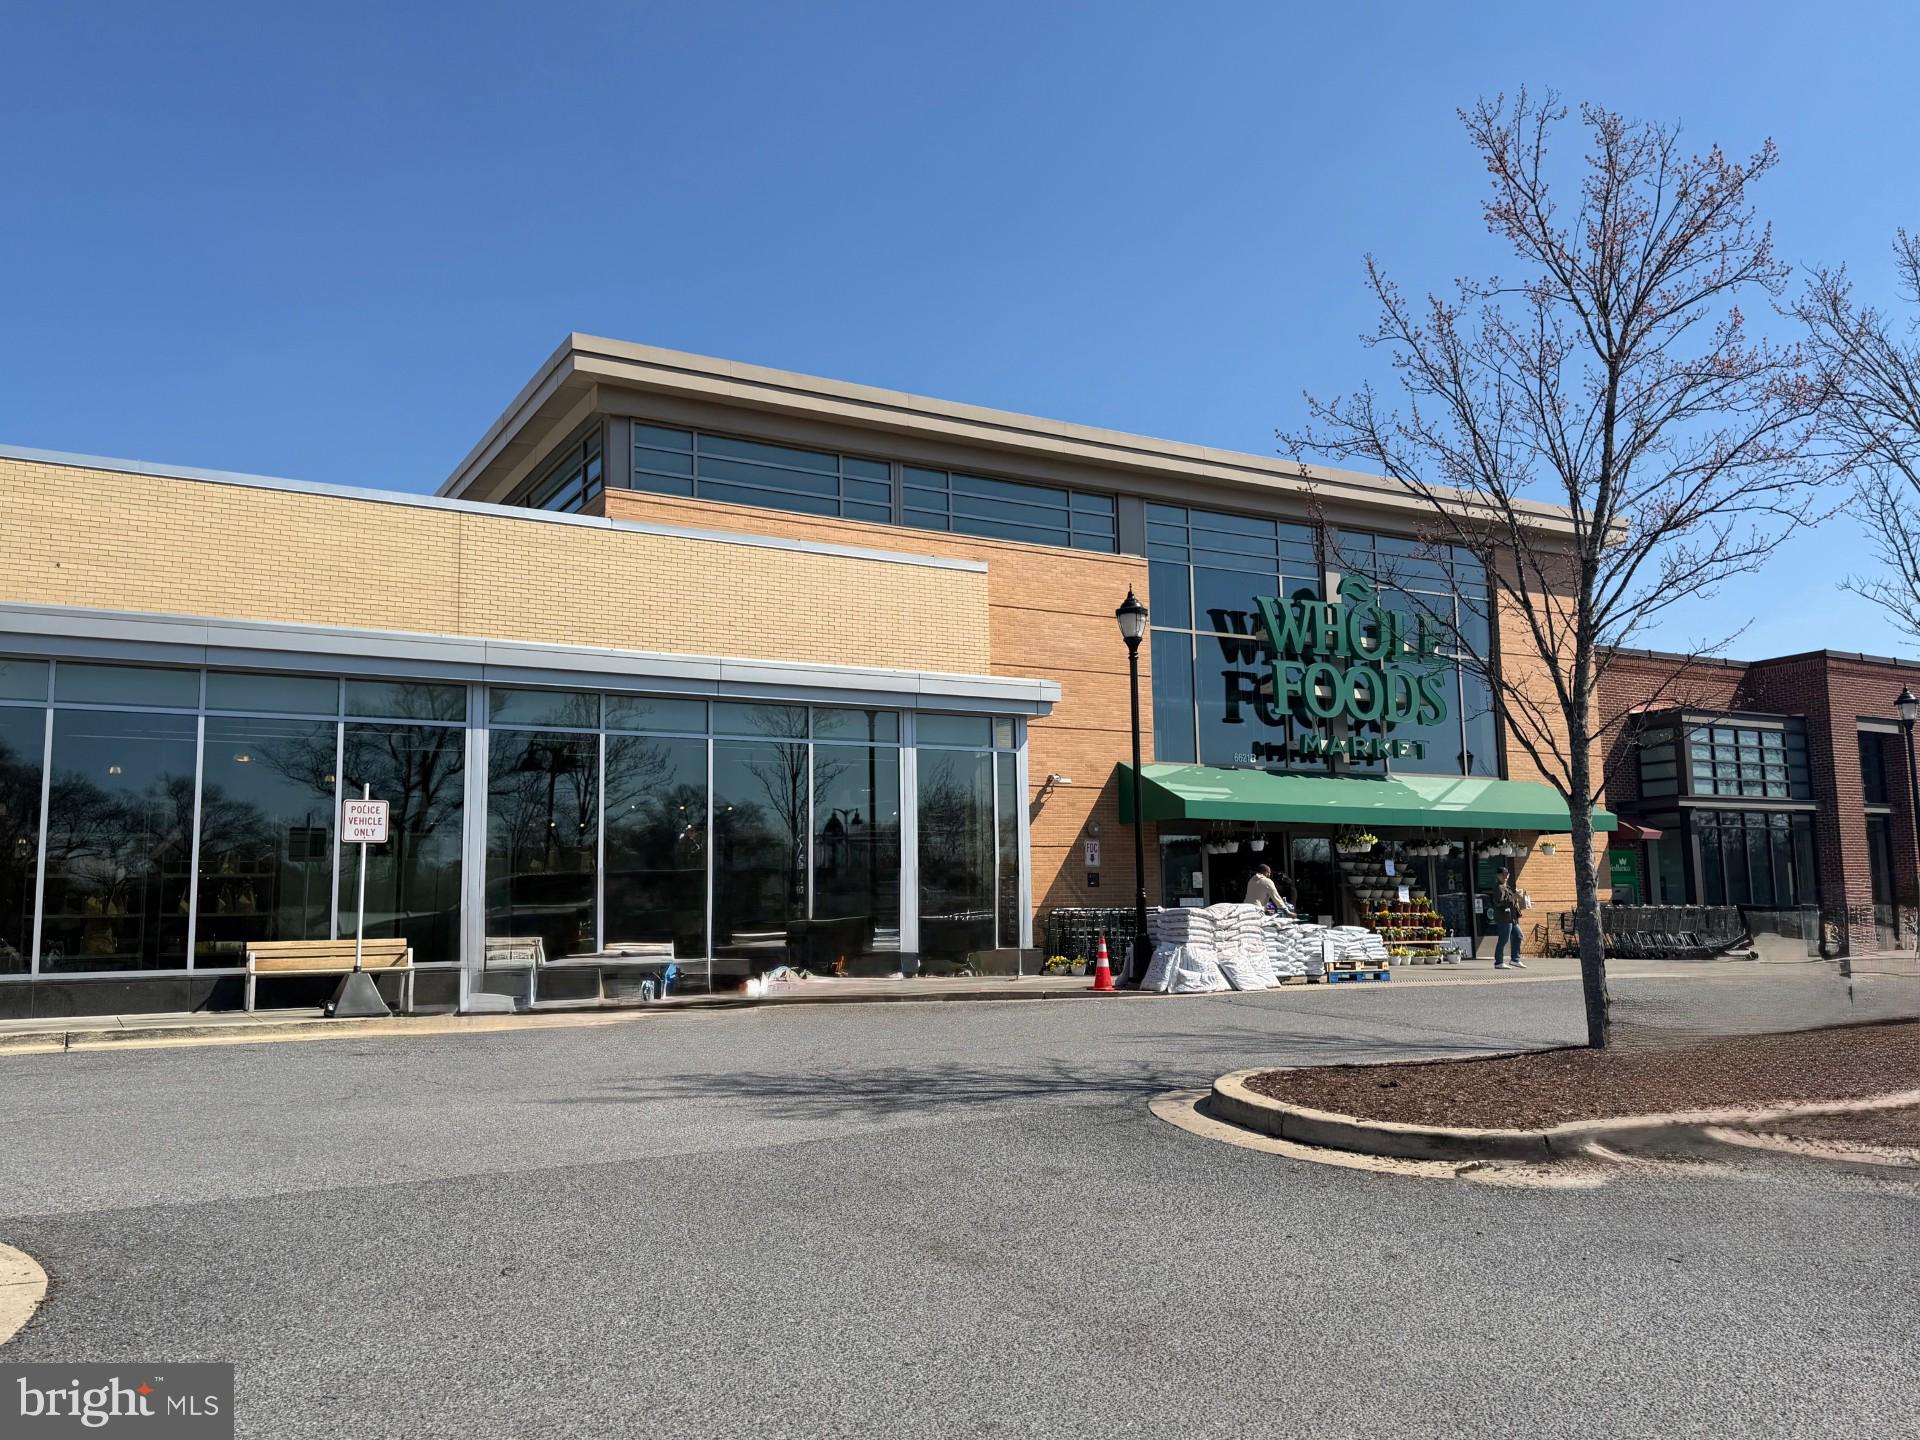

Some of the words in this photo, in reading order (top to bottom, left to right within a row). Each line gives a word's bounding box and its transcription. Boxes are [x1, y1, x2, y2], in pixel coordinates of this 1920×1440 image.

[1253, 596, 1450, 664] WHOLE
[1272, 660, 1448, 726] FOODS
[1301, 734, 1430, 760] MARKET
[351, 805, 381, 814] POLICE
[348, 816, 383, 826] VEHICLE
[353, 828, 376, 837] ONLY
[1086, 843, 1098, 853] FDC
